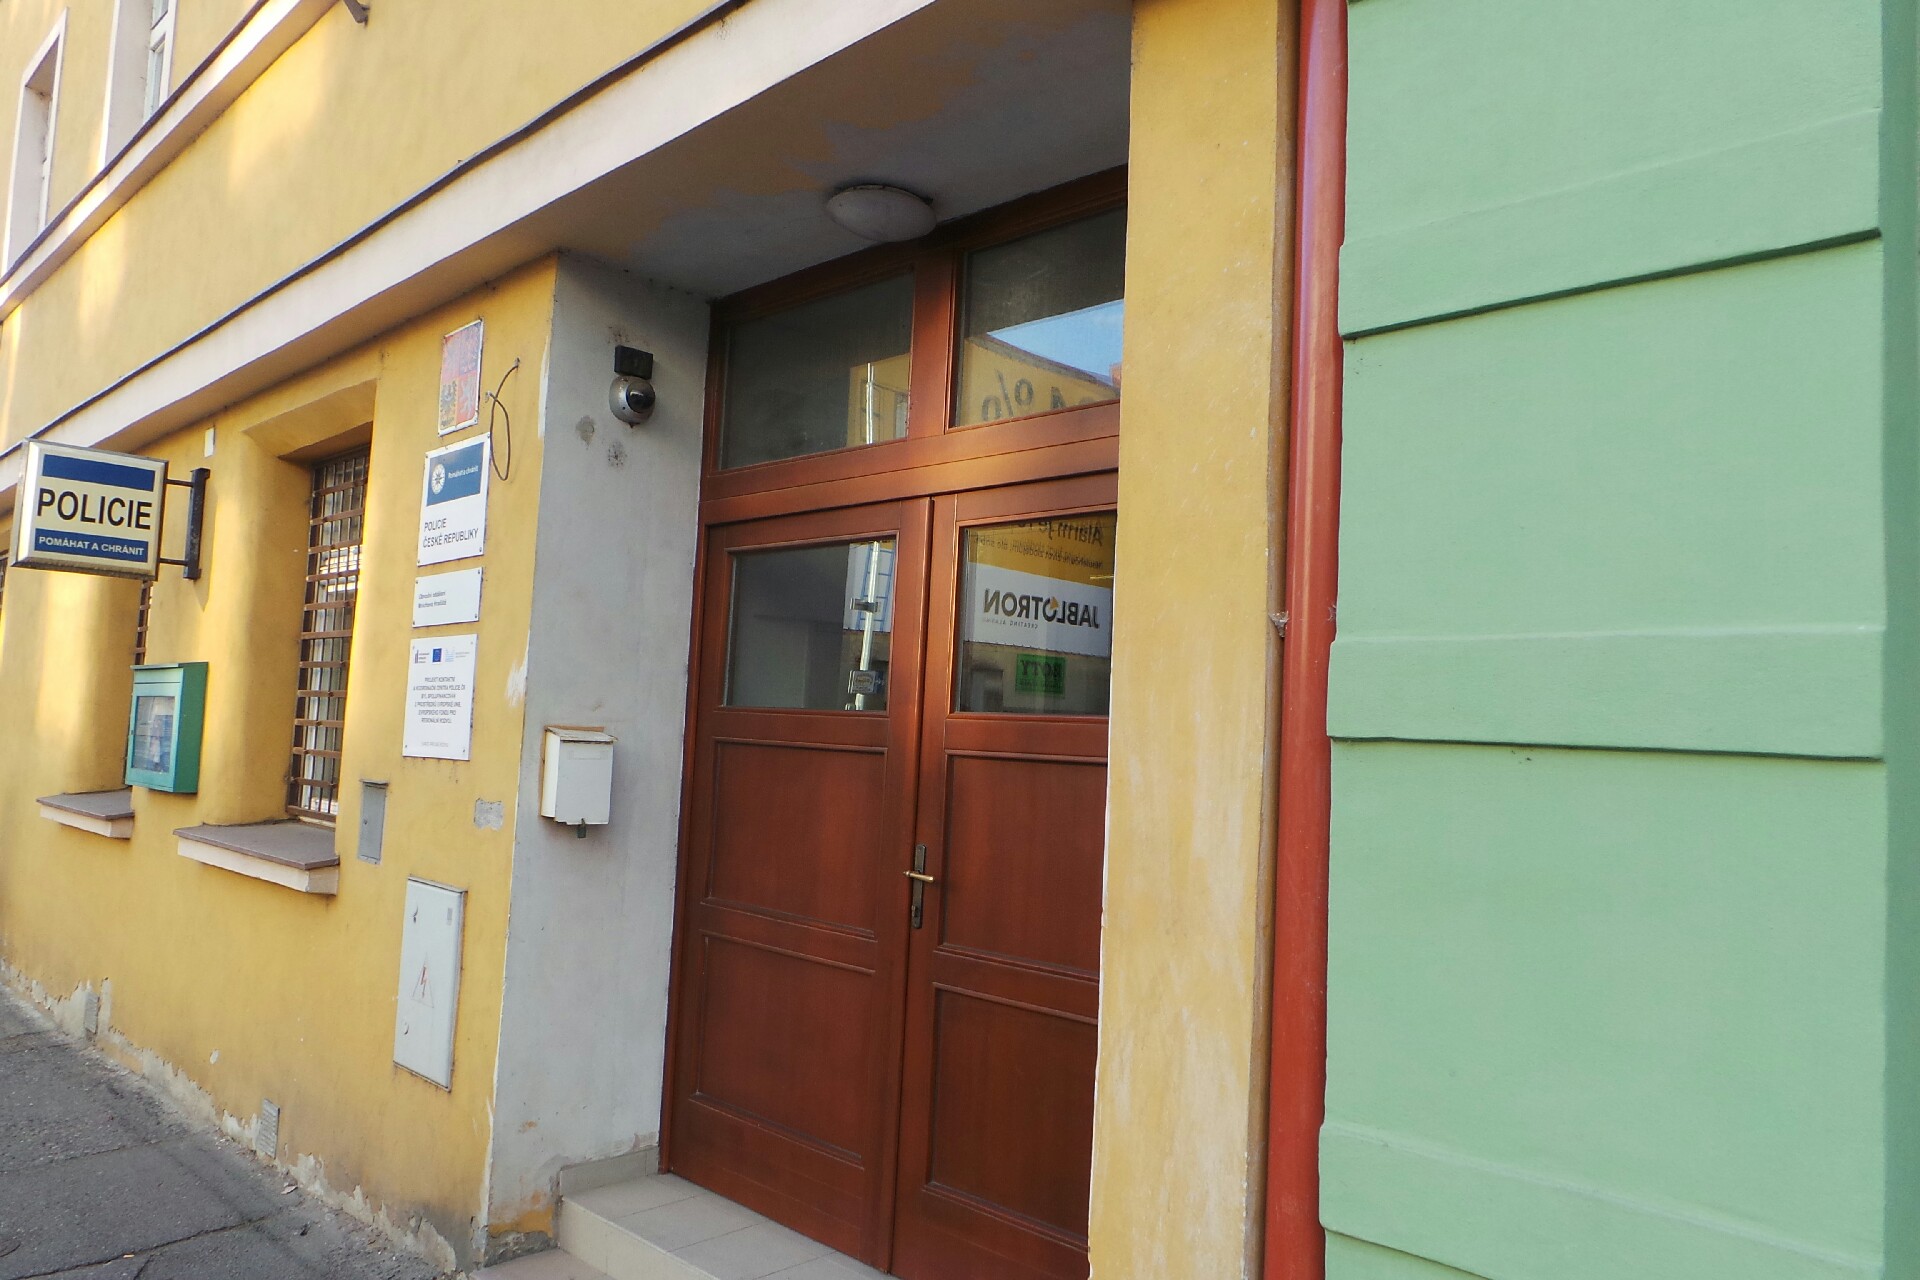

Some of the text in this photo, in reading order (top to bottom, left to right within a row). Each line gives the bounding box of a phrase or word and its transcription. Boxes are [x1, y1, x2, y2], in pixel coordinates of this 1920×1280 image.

[37, 487, 153, 530] POLICIE
[424, 518, 447, 532] POLICIE
[38, 535, 144, 556] POMÁHAT A CHRÁNIT
[422, 528, 479, 548] ČESKÉ REPUBLIKY
